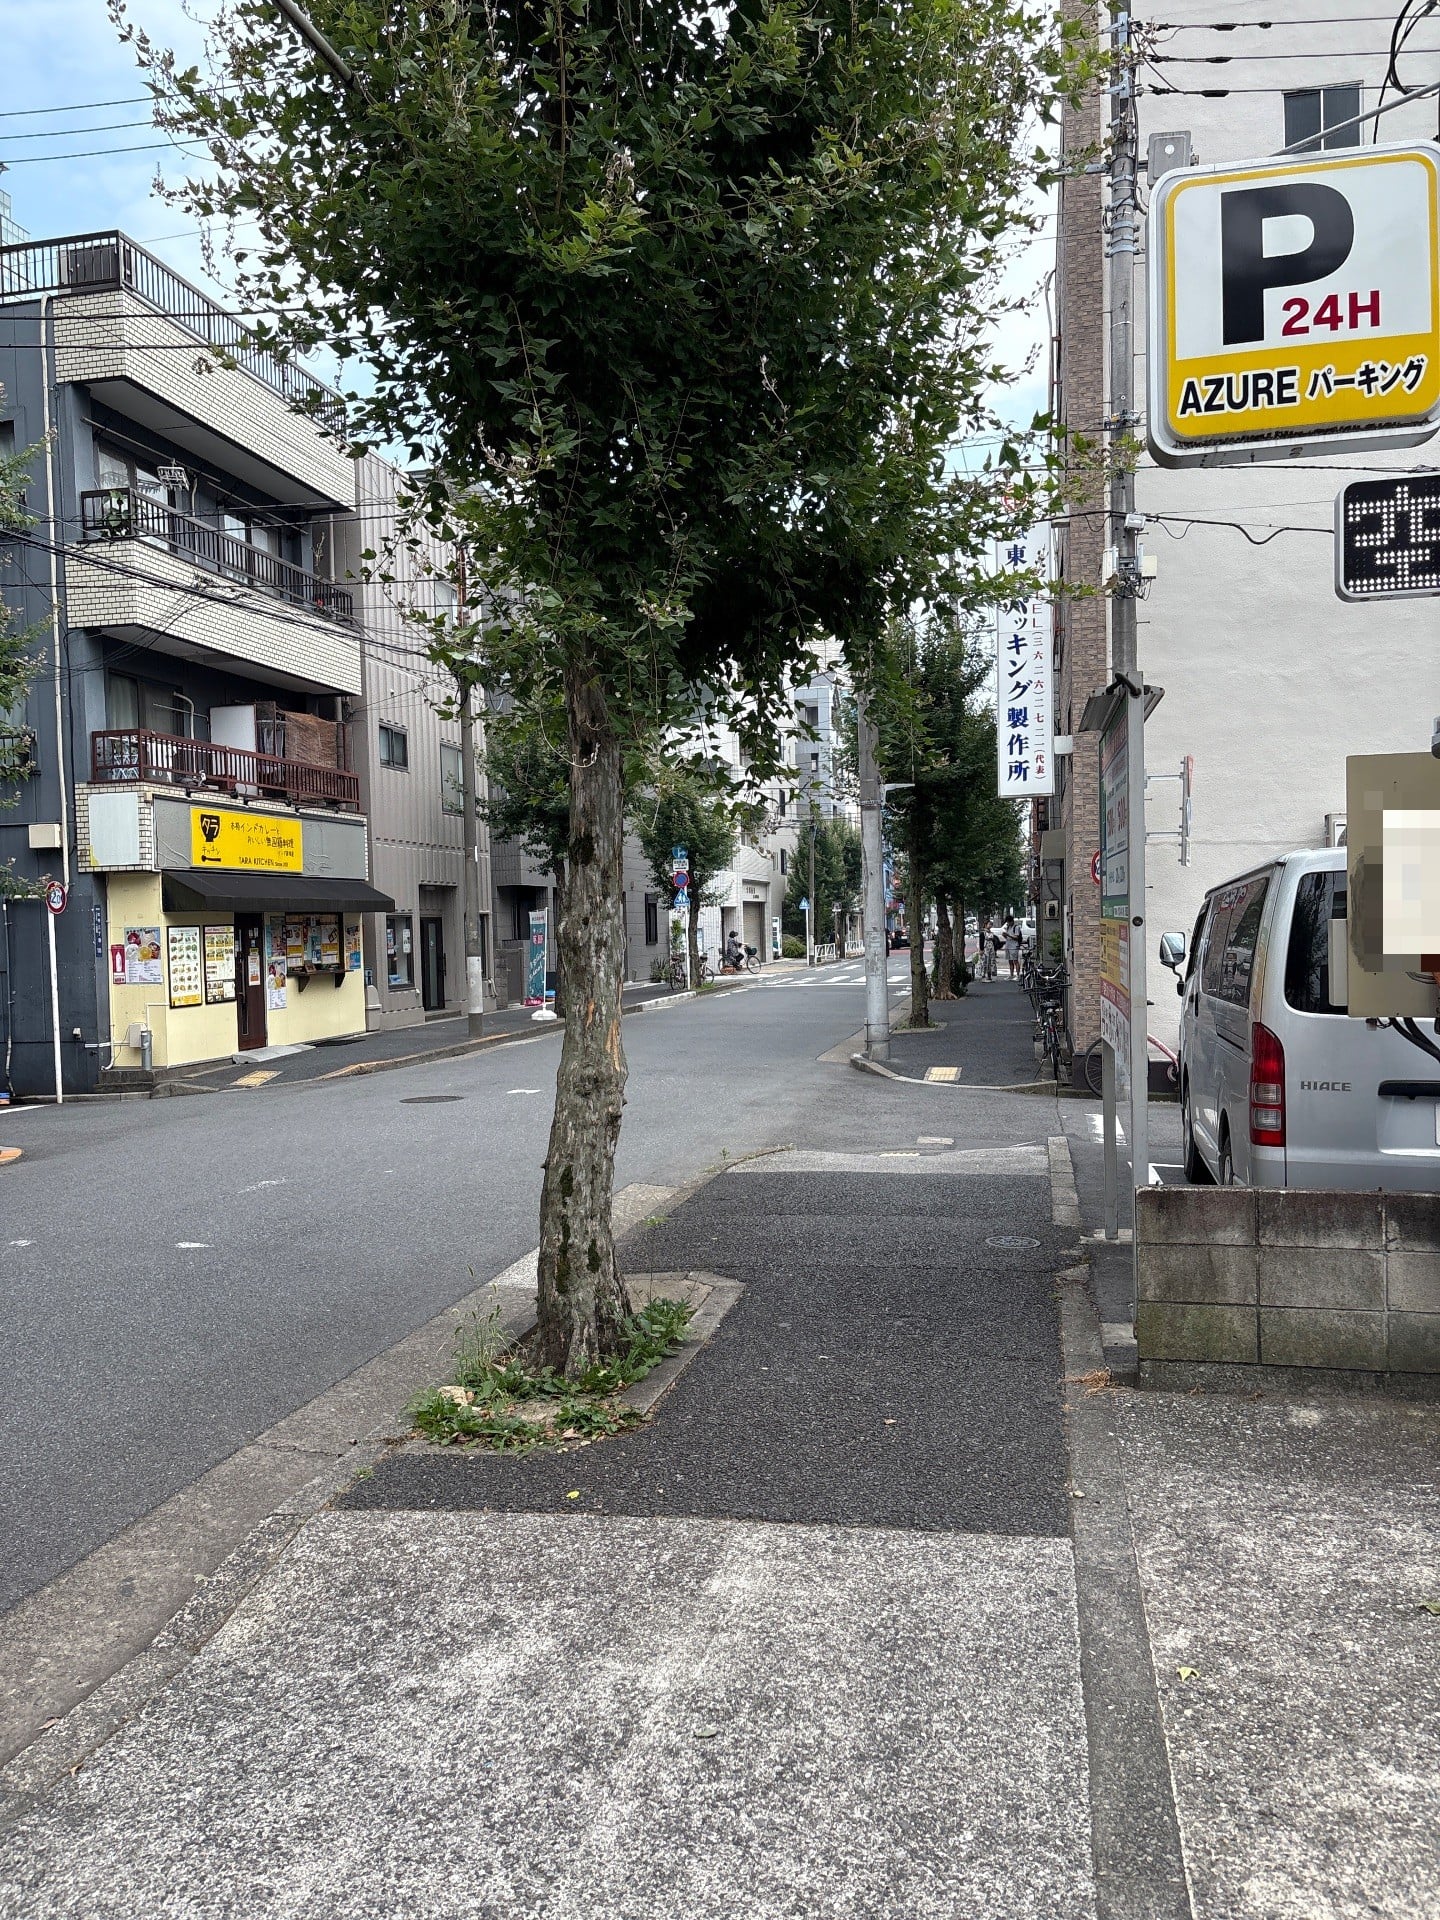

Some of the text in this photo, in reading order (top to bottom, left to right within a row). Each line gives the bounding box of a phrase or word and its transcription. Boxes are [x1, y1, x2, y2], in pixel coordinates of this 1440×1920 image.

[1221, 182, 1354, 346] P
[1281, 289, 1381, 336] 24H
[1179, 357, 1426, 416] AZURE パーキング
[1005, 543, 1030, 782] 東パッキング製作所
[202, 817, 219, 836] タラ
[1300, 1080, 1352, 1092] HIACE
